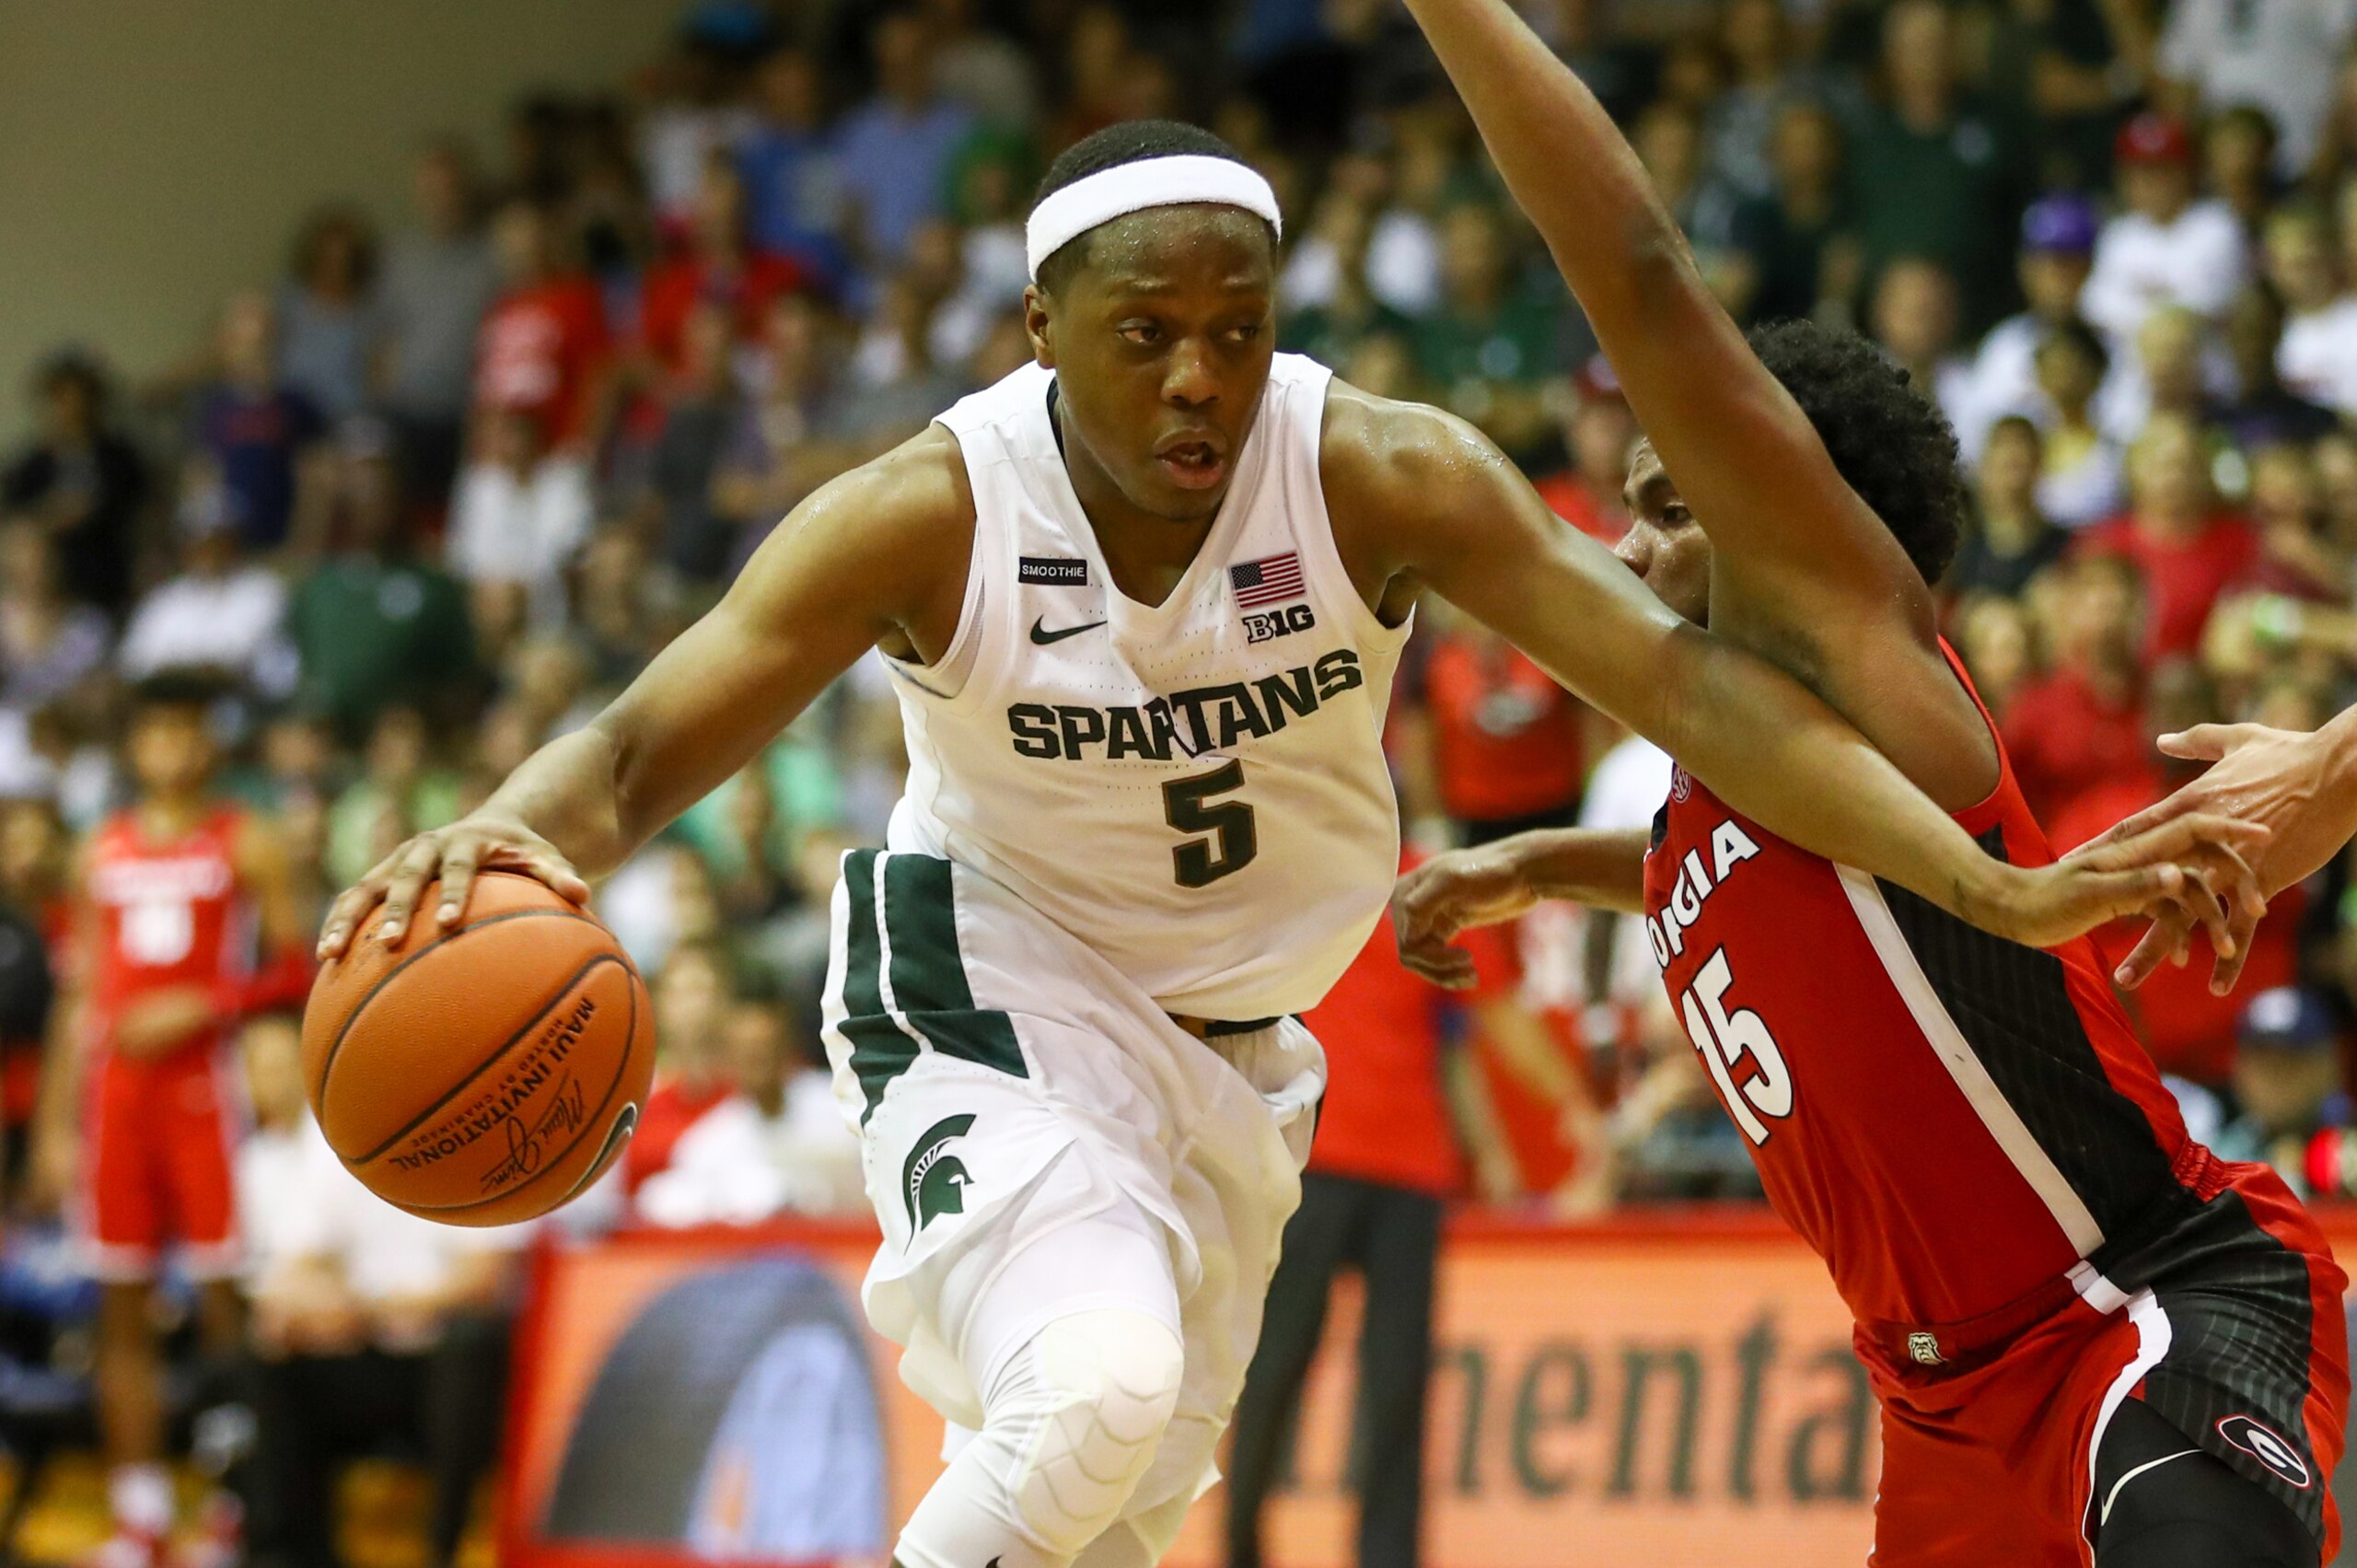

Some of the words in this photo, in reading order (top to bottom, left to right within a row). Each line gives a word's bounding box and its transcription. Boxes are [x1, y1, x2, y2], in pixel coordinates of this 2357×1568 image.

[1021, 564, 1086, 577] SMOOTHIE
[1007, 649, 1363, 761] SPARTANS
[1161, 758, 1258, 889] 5
[549, 996, 596, 1063] MAUI
[1680, 944, 1794, 1147] 15
[389, 1062, 552, 1171] INVITATIONAL
[498, 1074, 517, 1093] BY
[539, 1079, 584, 1144] Maui
[481, 1116, 540, 1194] Jim
